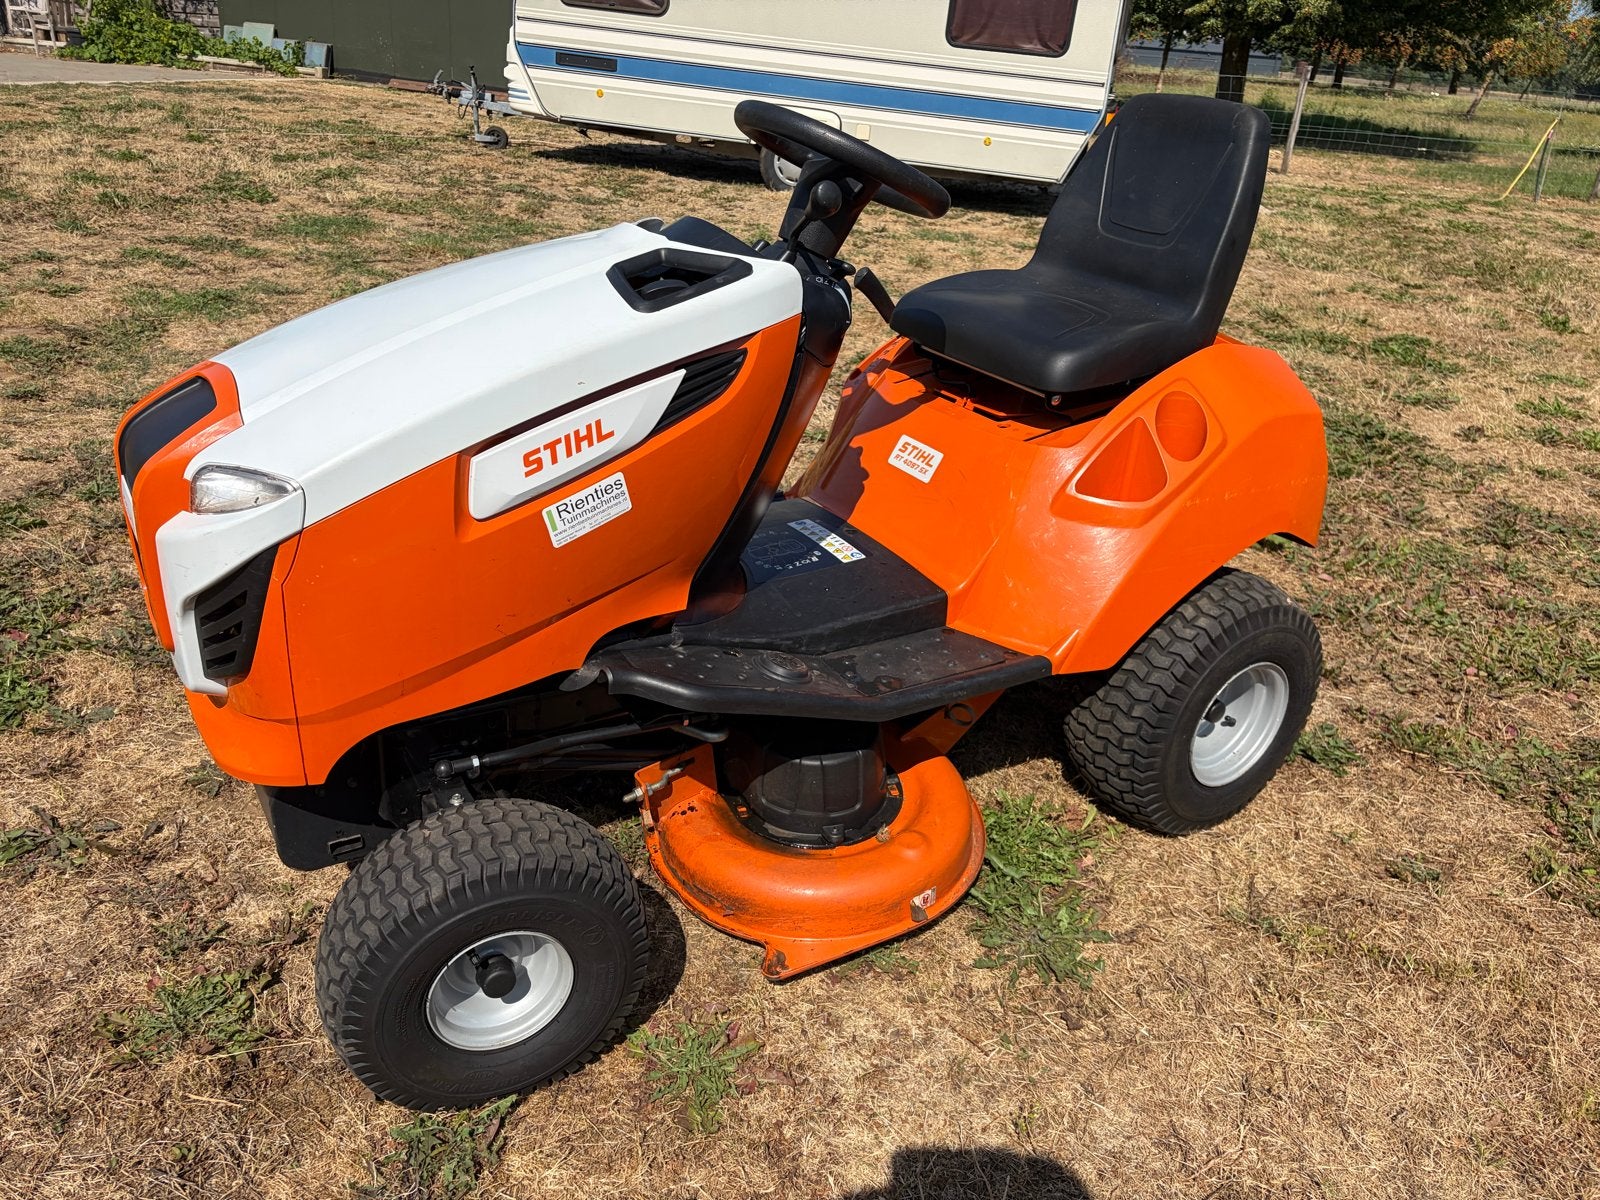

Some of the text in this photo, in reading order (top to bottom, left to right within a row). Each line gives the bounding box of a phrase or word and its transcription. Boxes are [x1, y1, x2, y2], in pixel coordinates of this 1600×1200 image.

[522, 418, 615, 478] STIHL
[893, 453, 930, 475] RT 4097 SX
[898, 441, 935, 468] STIHL
[556, 479, 623, 519] Rienties
[559, 490, 626, 527] Tuinmachines
